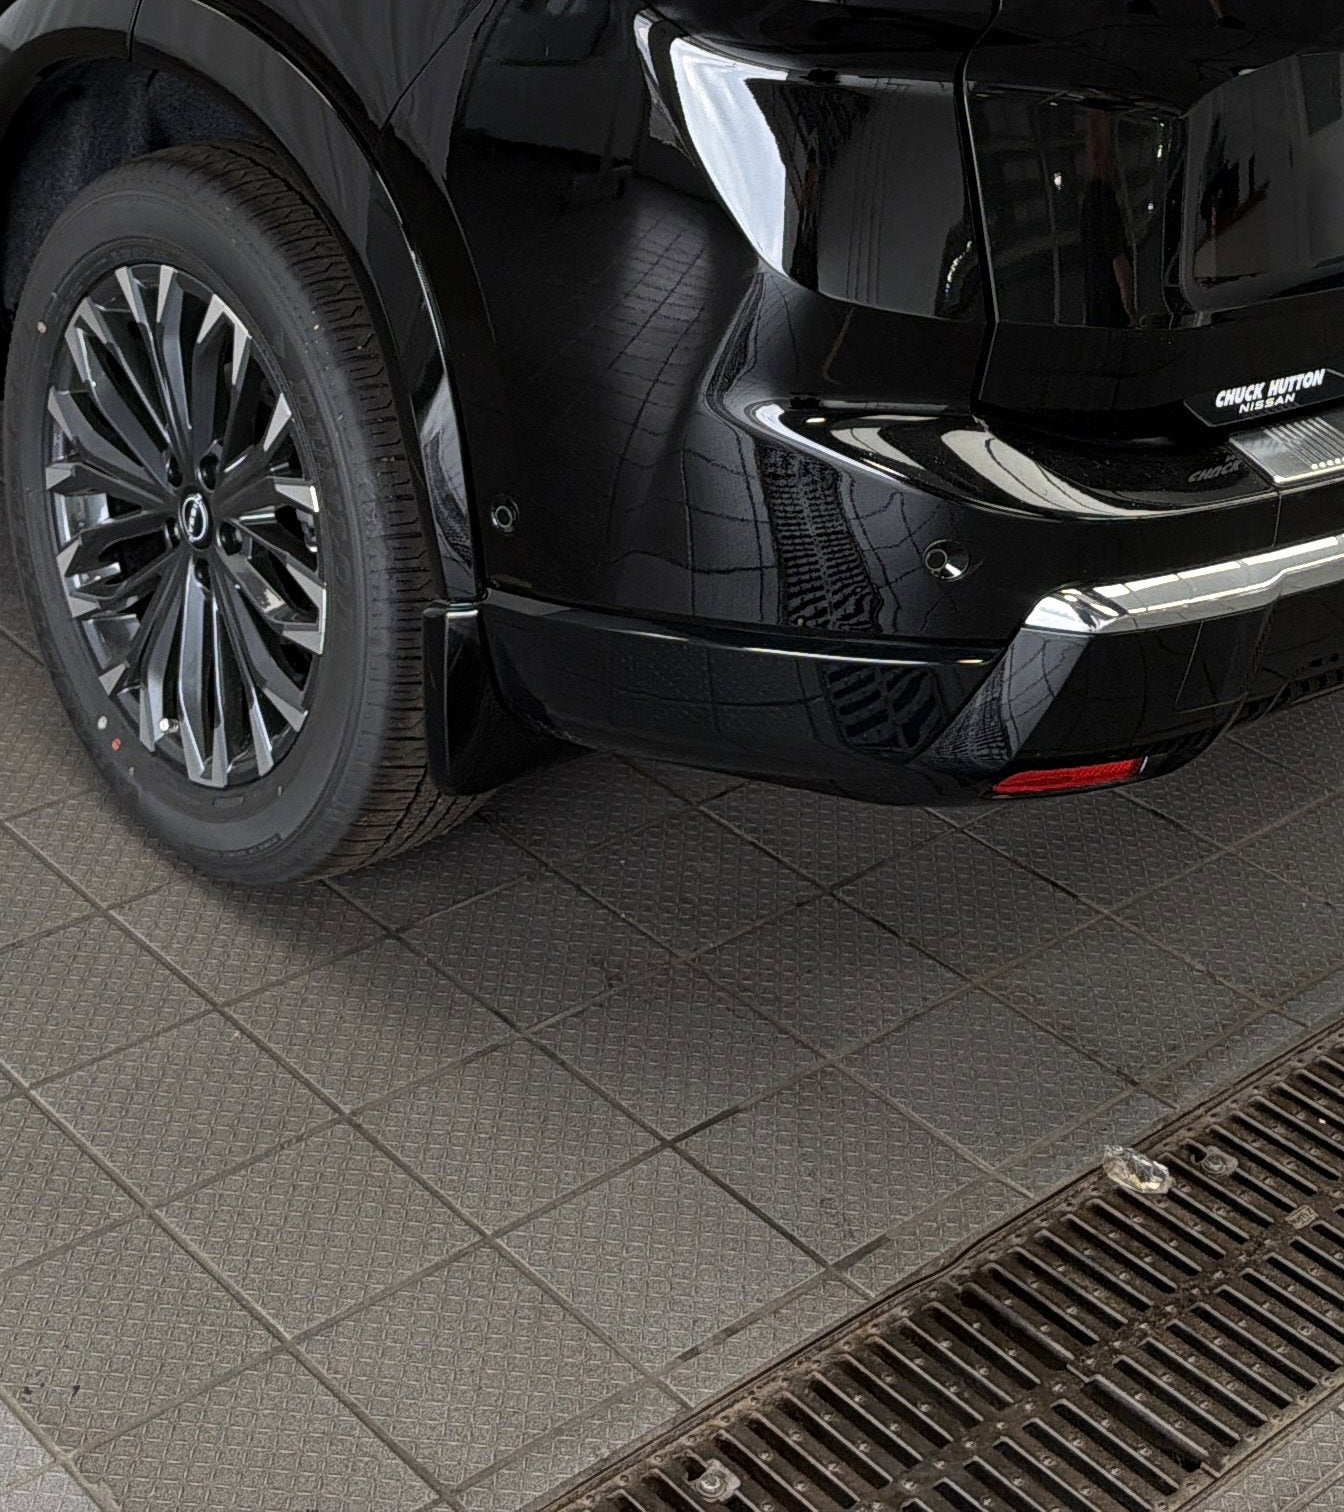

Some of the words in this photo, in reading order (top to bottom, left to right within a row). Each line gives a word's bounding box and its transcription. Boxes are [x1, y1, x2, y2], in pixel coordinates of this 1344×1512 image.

[1215, 381, 1265, 408] CHUCK
[1267, 367, 1326, 397] HUTTON
[1238, 392, 1297, 414] NISSAN
